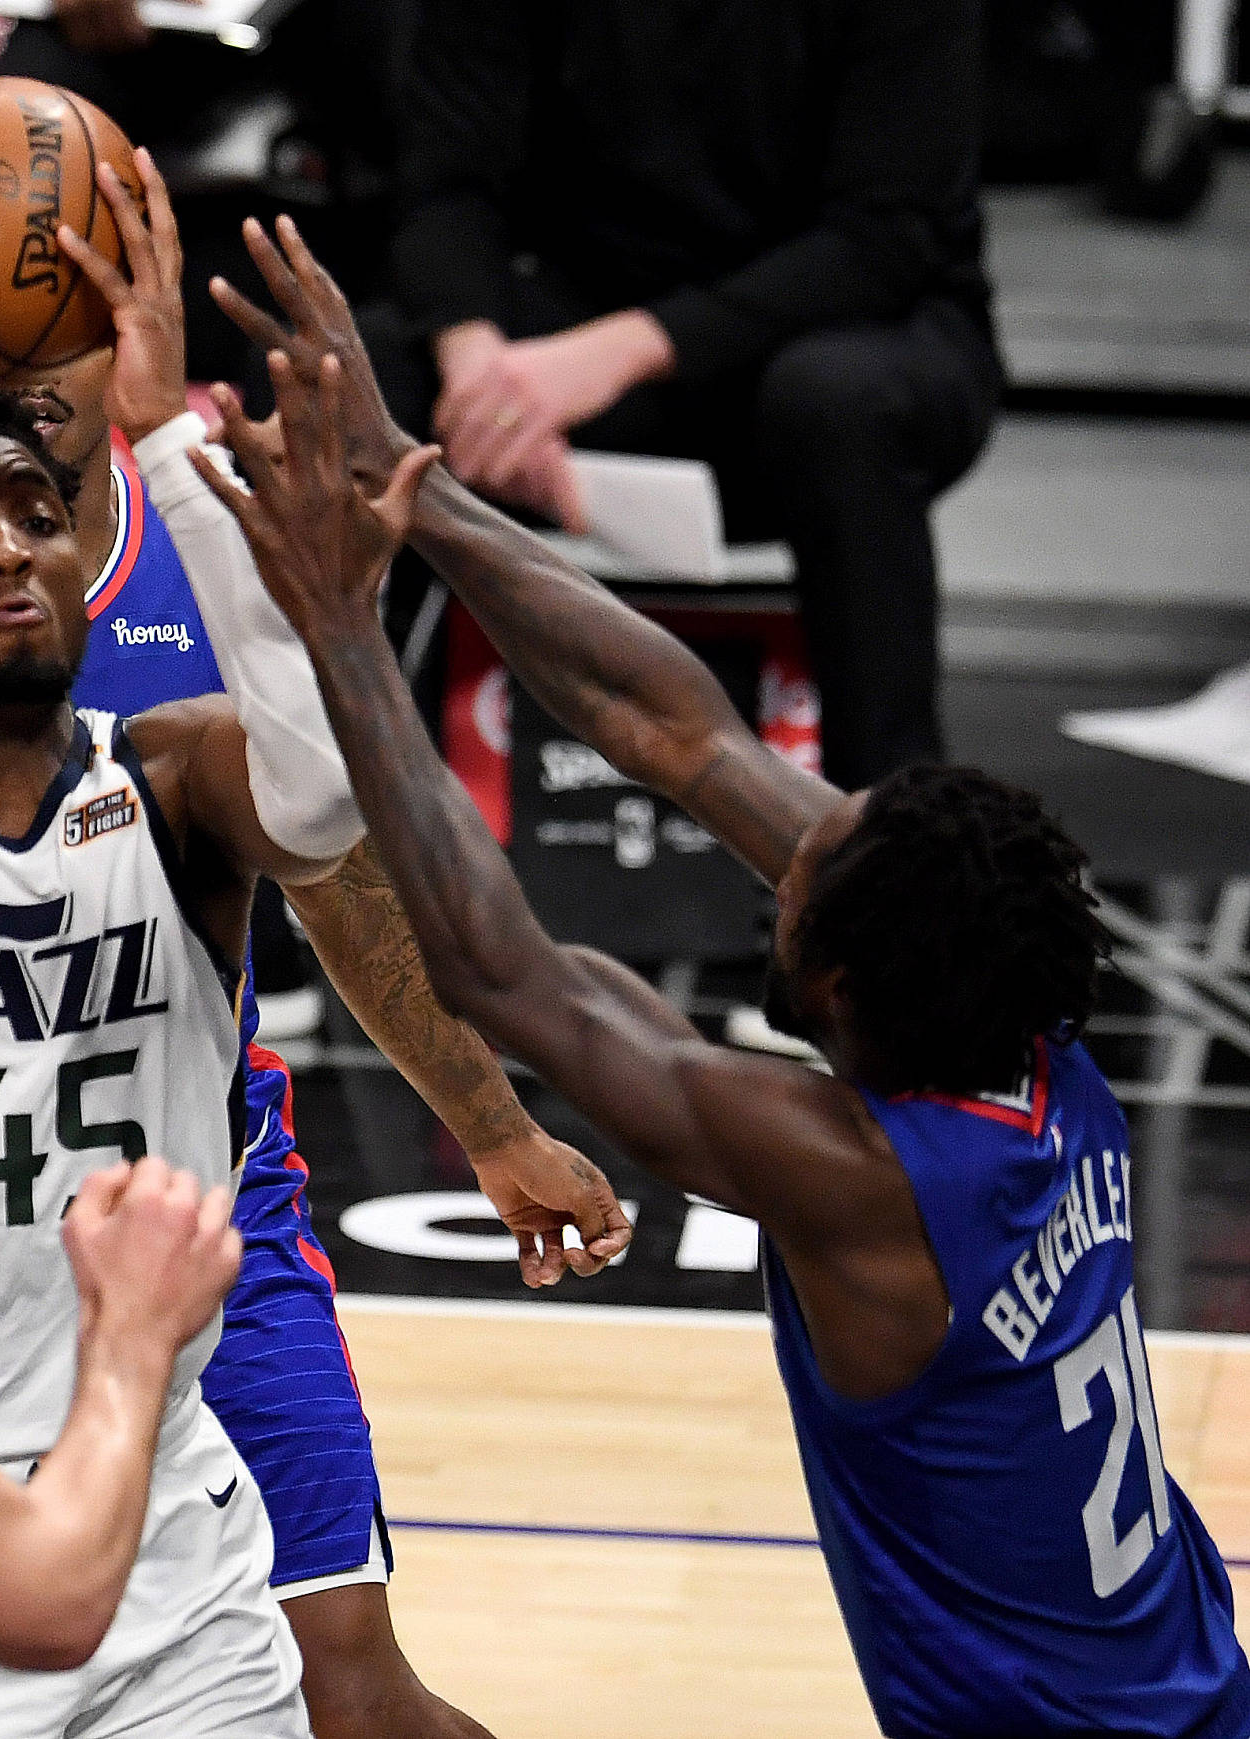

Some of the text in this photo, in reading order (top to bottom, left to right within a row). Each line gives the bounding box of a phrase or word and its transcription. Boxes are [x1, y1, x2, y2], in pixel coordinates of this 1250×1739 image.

[12, 95, 63, 294] SPALDIN
[110, 617, 194, 652] honey
[65, 812, 82, 845] 5
[1053, 1285, 1171, 1599] 21
